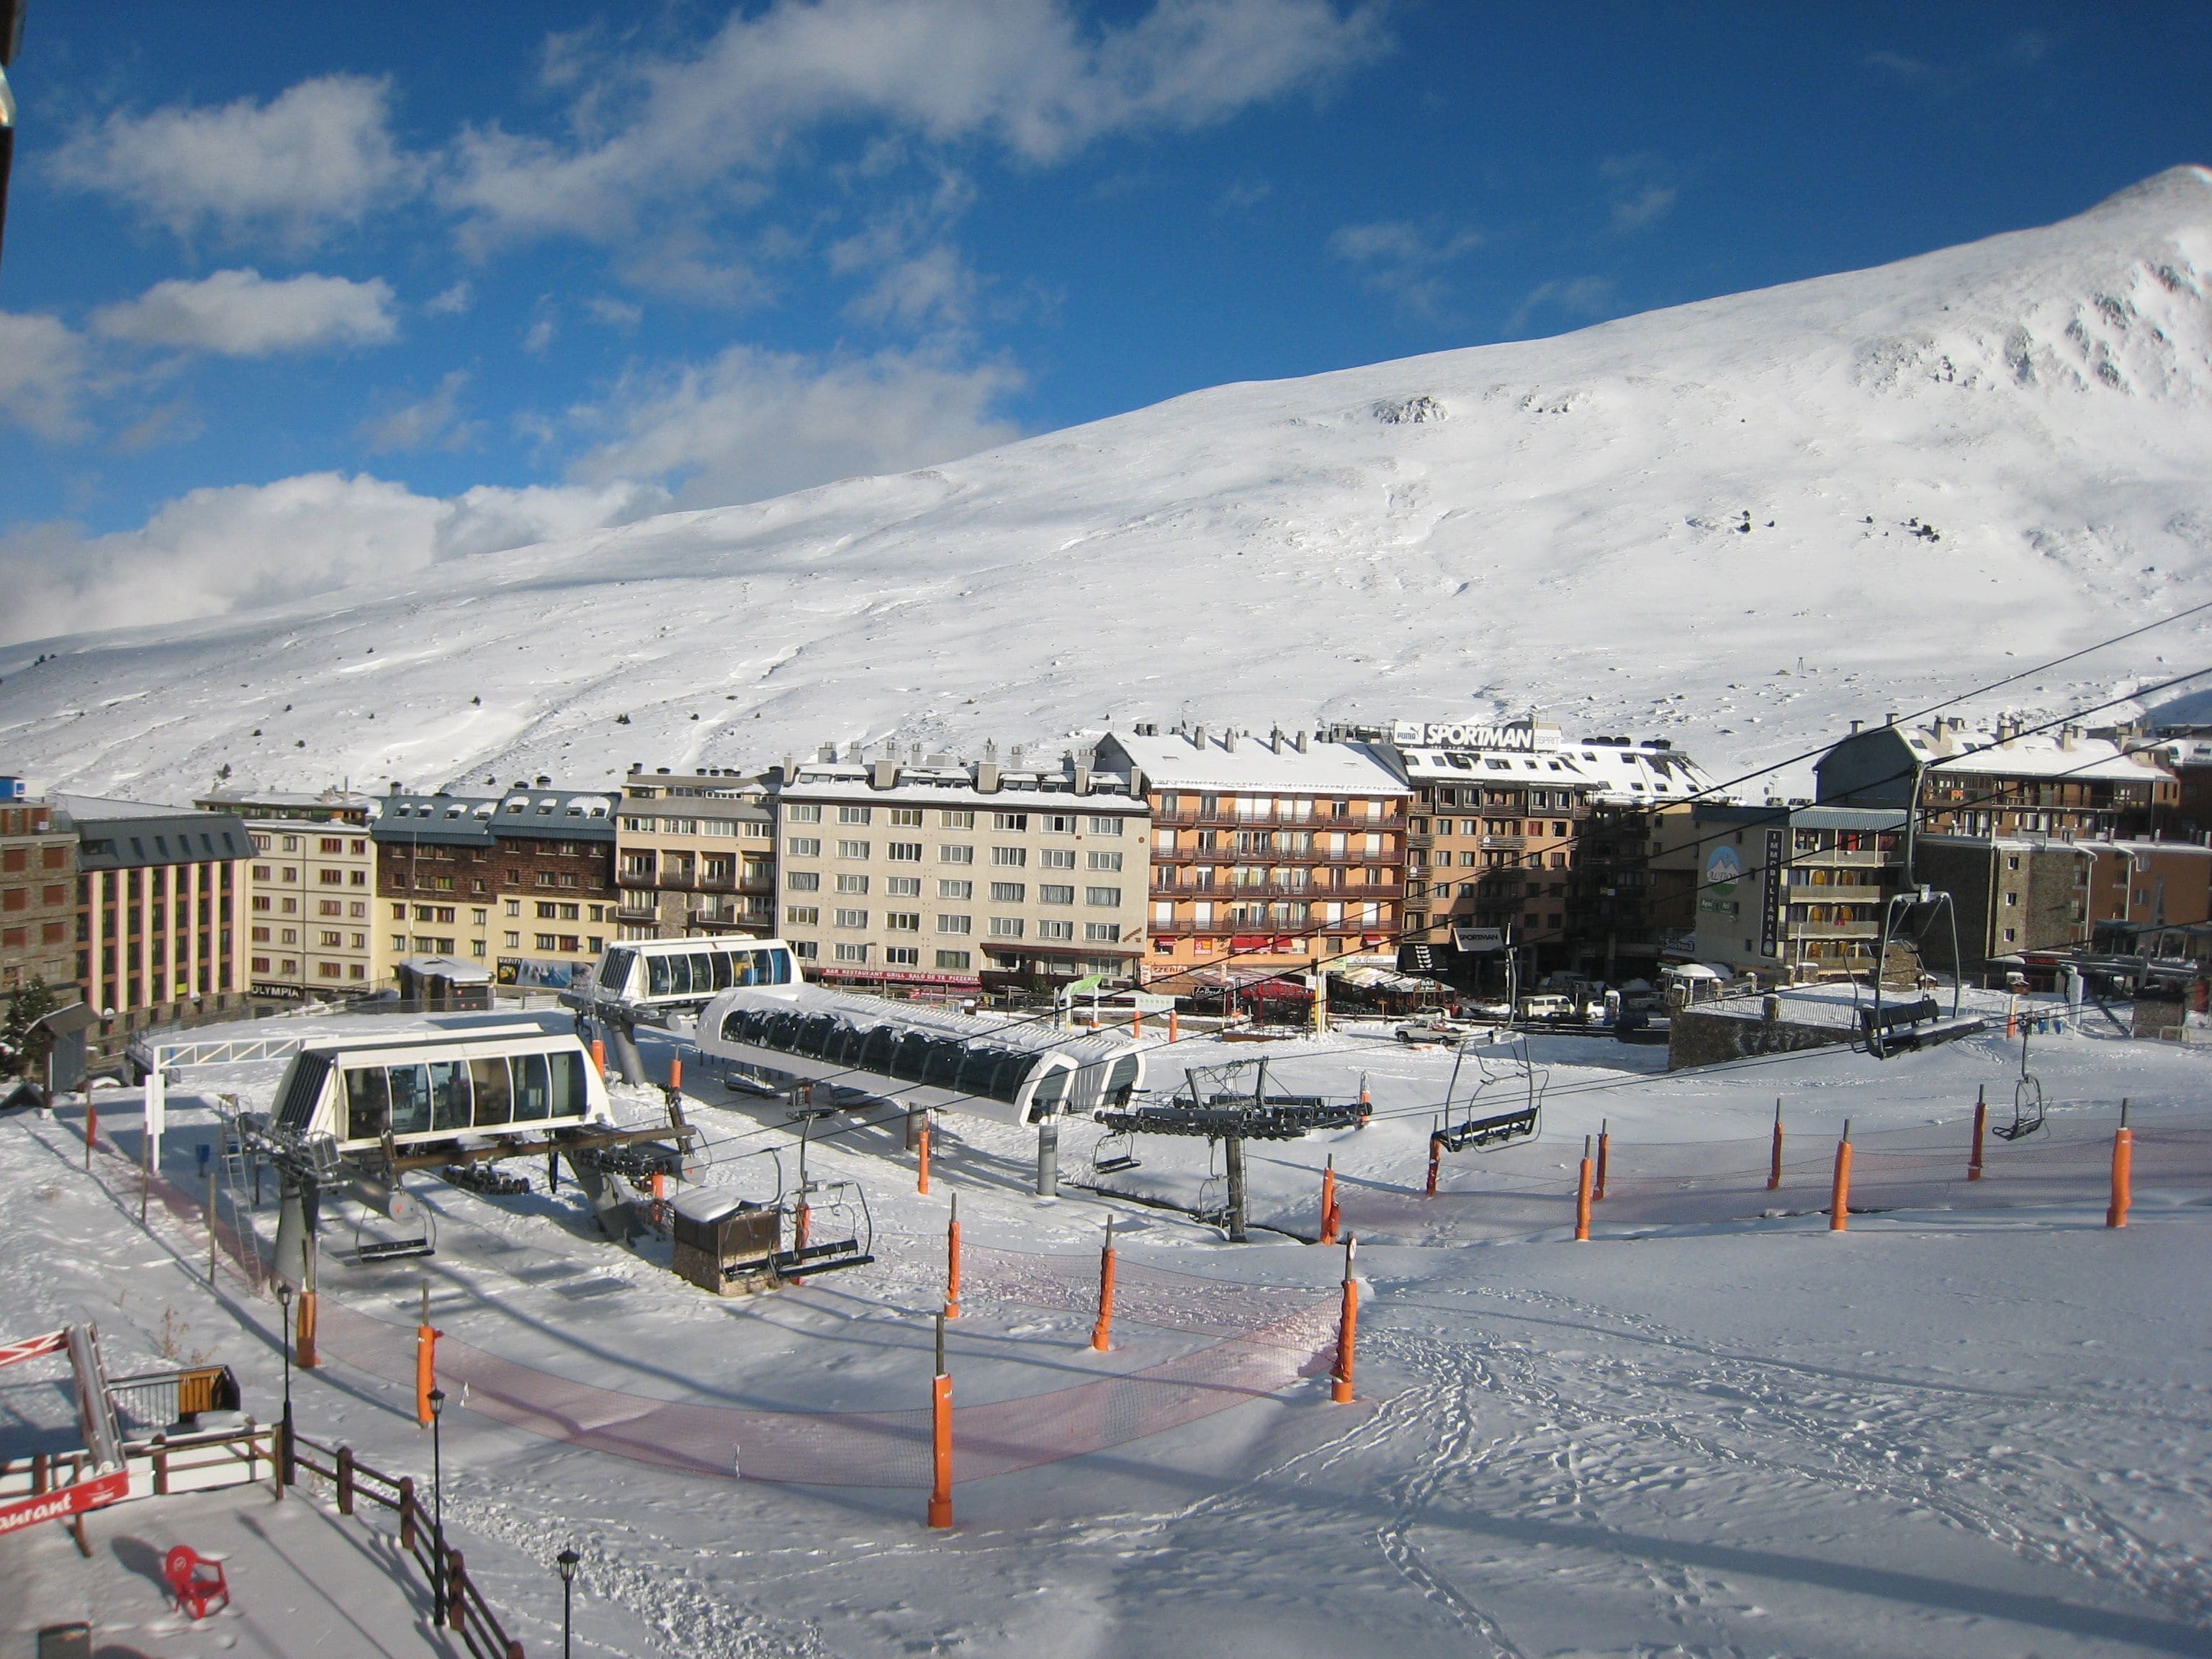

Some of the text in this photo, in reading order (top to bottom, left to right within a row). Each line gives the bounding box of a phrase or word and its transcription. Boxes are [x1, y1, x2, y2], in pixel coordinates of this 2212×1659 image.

[1397, 732, 1416, 740] PUMA
[1426, 724, 1533, 748] SPORTMAN
[1534, 736, 1560, 745] ESPRIT
[252, 984, 300, 997] OLYMPIA
